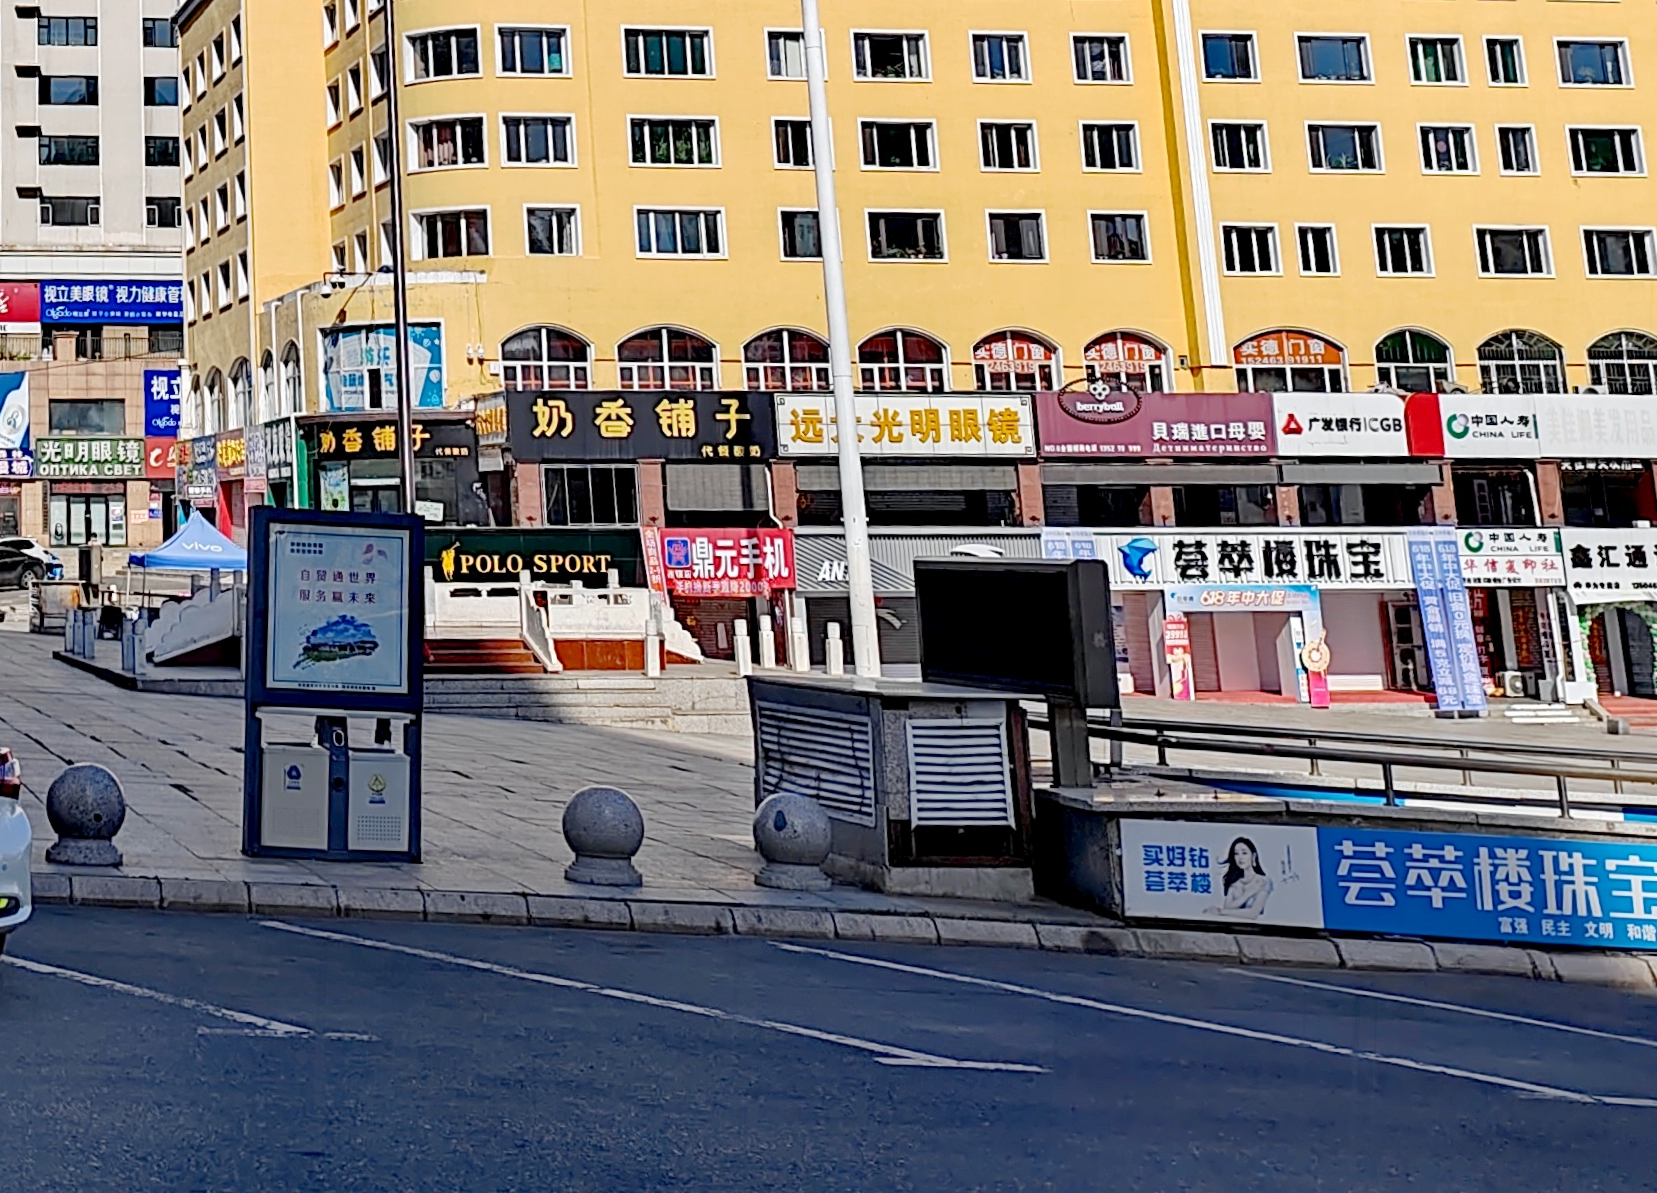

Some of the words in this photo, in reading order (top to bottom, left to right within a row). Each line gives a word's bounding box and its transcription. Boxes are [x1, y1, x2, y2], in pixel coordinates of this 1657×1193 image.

[532, 398, 751, 439] 奶香铺子
[1308, 417, 1362, 433] 广发银行
[1369, 418, 1403, 432] CGB
[1471, 414, 1530, 427] 中国人寿
[1472, 431, 1505, 439] CHINA
[1511, 431, 1533, 439] LIFE
[41, 439, 141, 463] 光明眼镜
[39, 464, 99, 476] ОПТИКА
[103, 464, 142, 476] СВЕТ
[181, 539, 223, 554] vivo
[1489, 532, 1548, 543] 中国人寿
[459, 554, 523, 574] POLO
[533, 554, 611, 574] SPORT
[692, 536, 789, 579] 鼎元手机
[1173, 539, 1385, 579] 荟萃楼珠宝
[1569, 544, 1657, 569] 鑫汇通
[300, 568, 376, 584] 自贸通世界
[817, 560, 849, 582] AN
[299, 589, 376, 604] 服务赢未来
[1200, 590, 1286, 606] 618年中大促
[1141, 843, 1211, 868] 买好钻
[1144, 871, 1212, 896] 荟萃楼
[1334, 839, 1657, 920] 荟萃楼珠宝
[1498, 916, 1529, 935] 富强
[1541, 919, 1573, 938] 民主
[1584, 921, 1615, 940] 文明
[1627, 922, 1657, 942] 和谐
